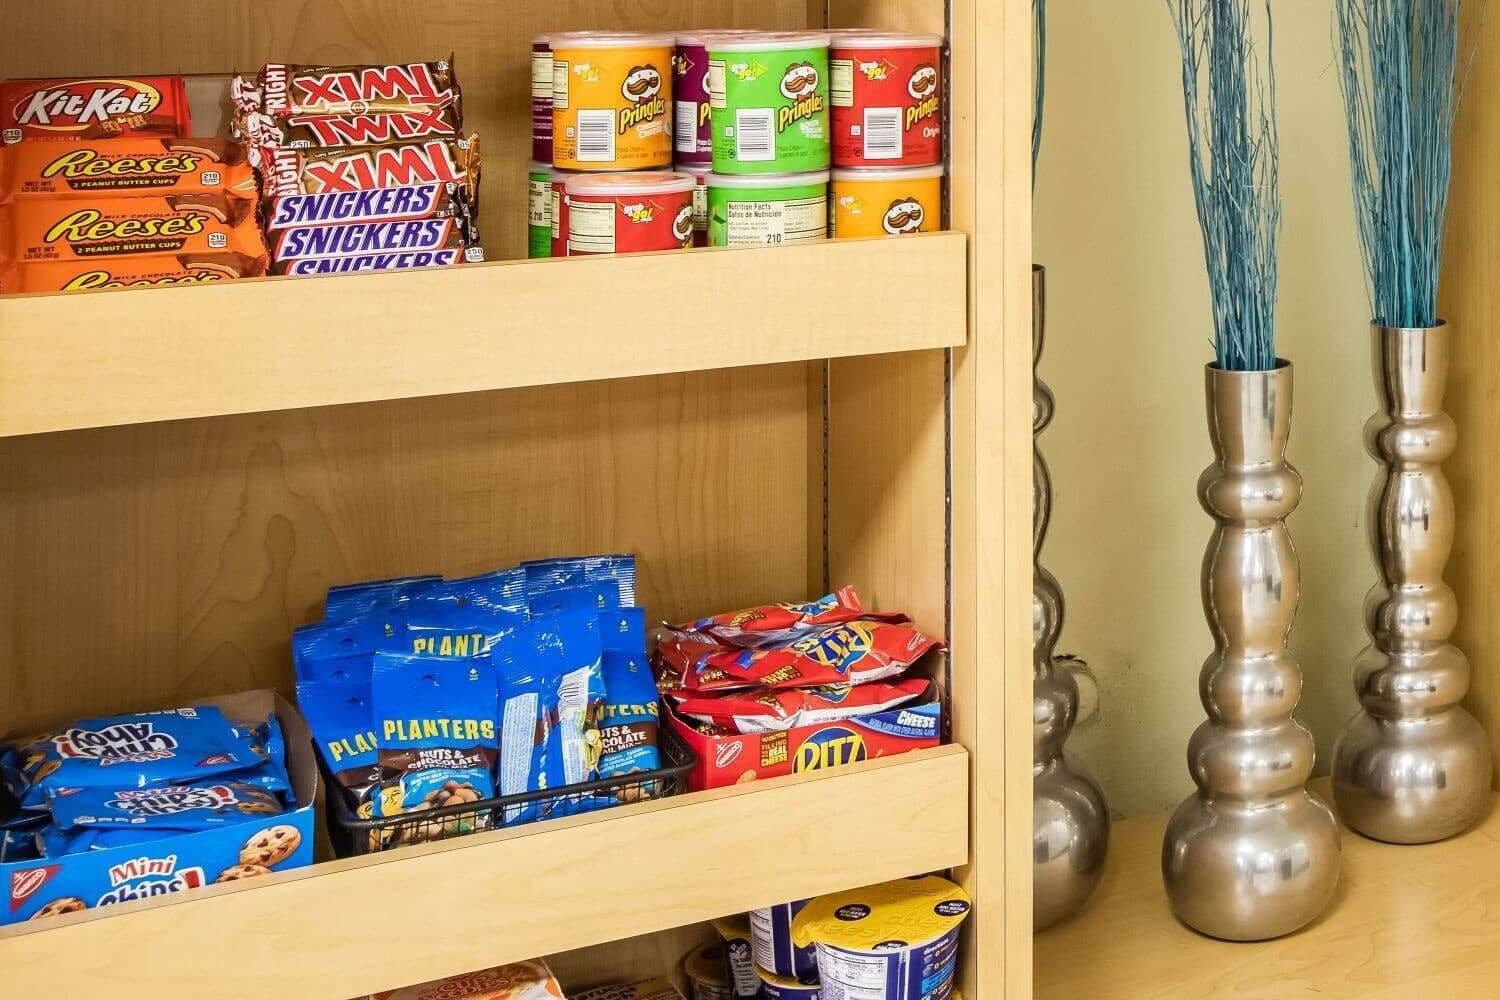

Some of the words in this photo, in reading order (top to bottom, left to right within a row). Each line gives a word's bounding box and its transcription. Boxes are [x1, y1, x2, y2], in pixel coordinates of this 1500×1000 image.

[619, 96, 665, 134] Pringles
[779, 94, 824, 133] Pringles
[290, 110, 455, 148] TWIX
[43, 150, 200, 178] Reese's
[277, 185, 436, 225] SNICKERS
[46, 209, 209, 243] Reese's
[282, 219, 446, 257] SNICKERS
[767, 234, 782, 244] 210
[413, 633, 489, 656] PLANT
[383, 719, 495, 741] PLANTERS
[622, 725, 631, 735] &
[897, 711, 936, 728] CHEESE
[602, 731, 647, 748] COLATE
[602, 747, 616, 755] AIL
[407, 755, 481, 770] CHOCOLATE
[419, 749, 452, 760] NUTS
[453, 750, 464, 760] &
[111, 856, 174, 885] Mini
